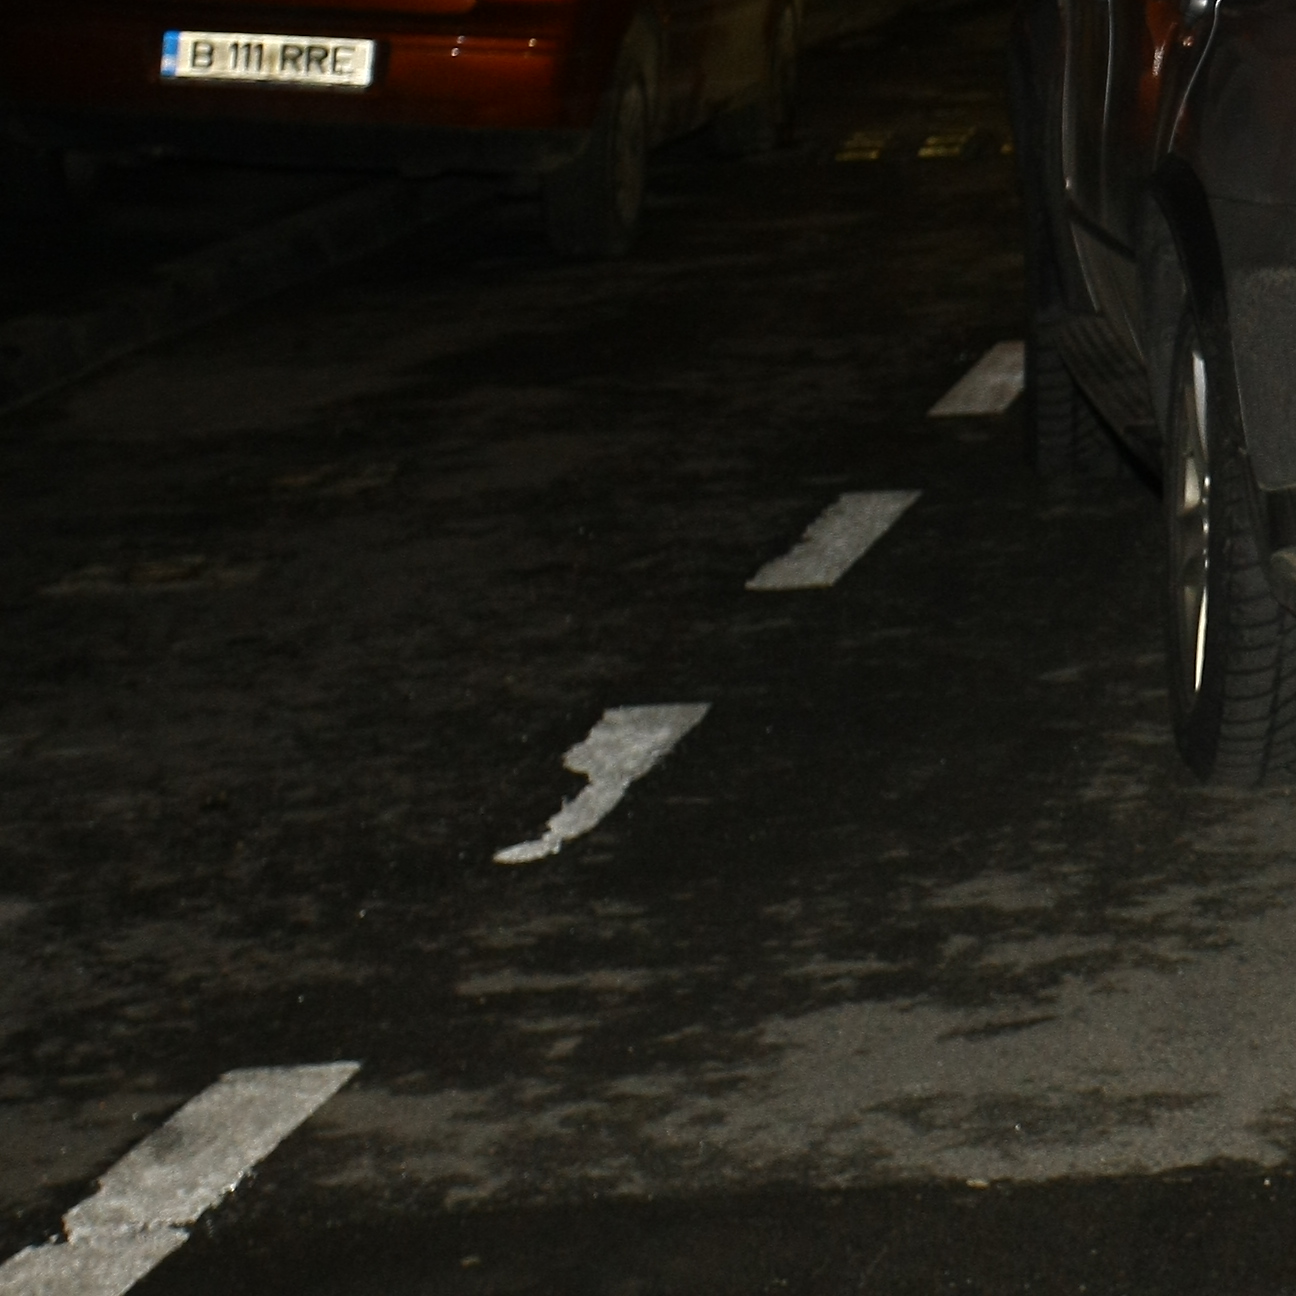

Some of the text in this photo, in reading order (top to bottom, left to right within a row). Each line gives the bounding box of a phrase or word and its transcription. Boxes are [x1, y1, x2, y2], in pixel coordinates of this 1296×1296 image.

[191, 40, 356, 75] B 111 RRE
